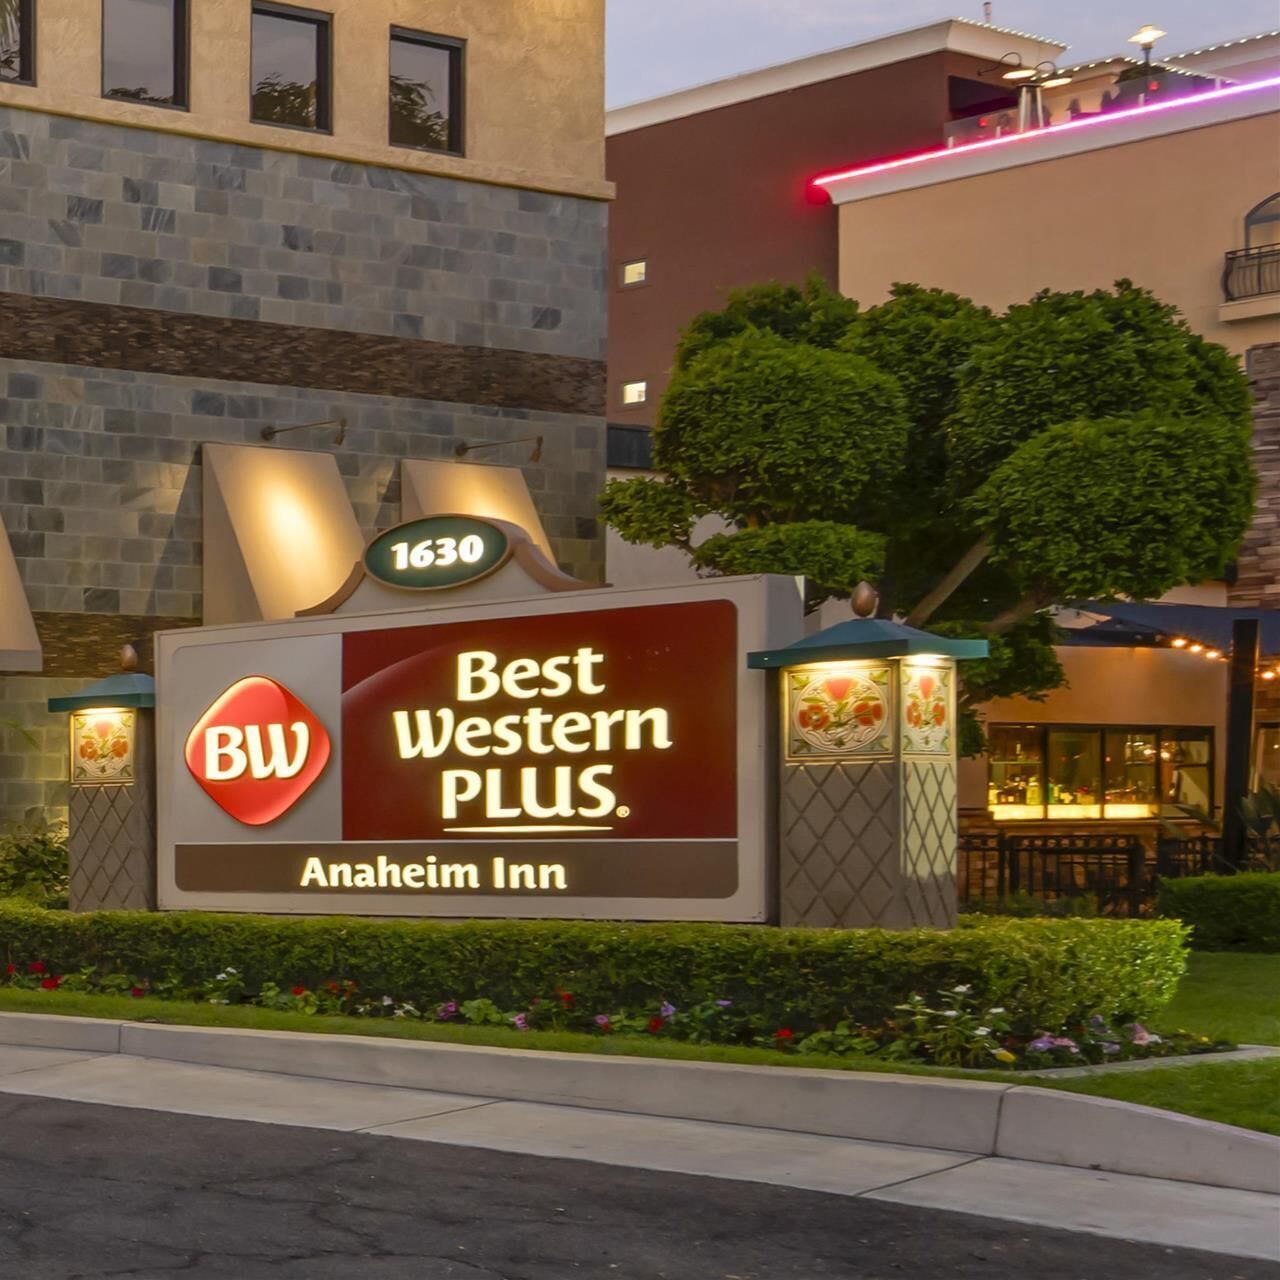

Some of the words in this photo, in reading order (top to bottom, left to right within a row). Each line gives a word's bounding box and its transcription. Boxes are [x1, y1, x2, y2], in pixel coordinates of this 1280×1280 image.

[391, 534, 484, 570] 1630
[457, 647, 606, 701] Best
[205, 721, 310, 780] BW
[393, 707, 673, 759] Western
[300, 855, 481, 888] Anaheim
[493, 857, 568, 889] Inn
